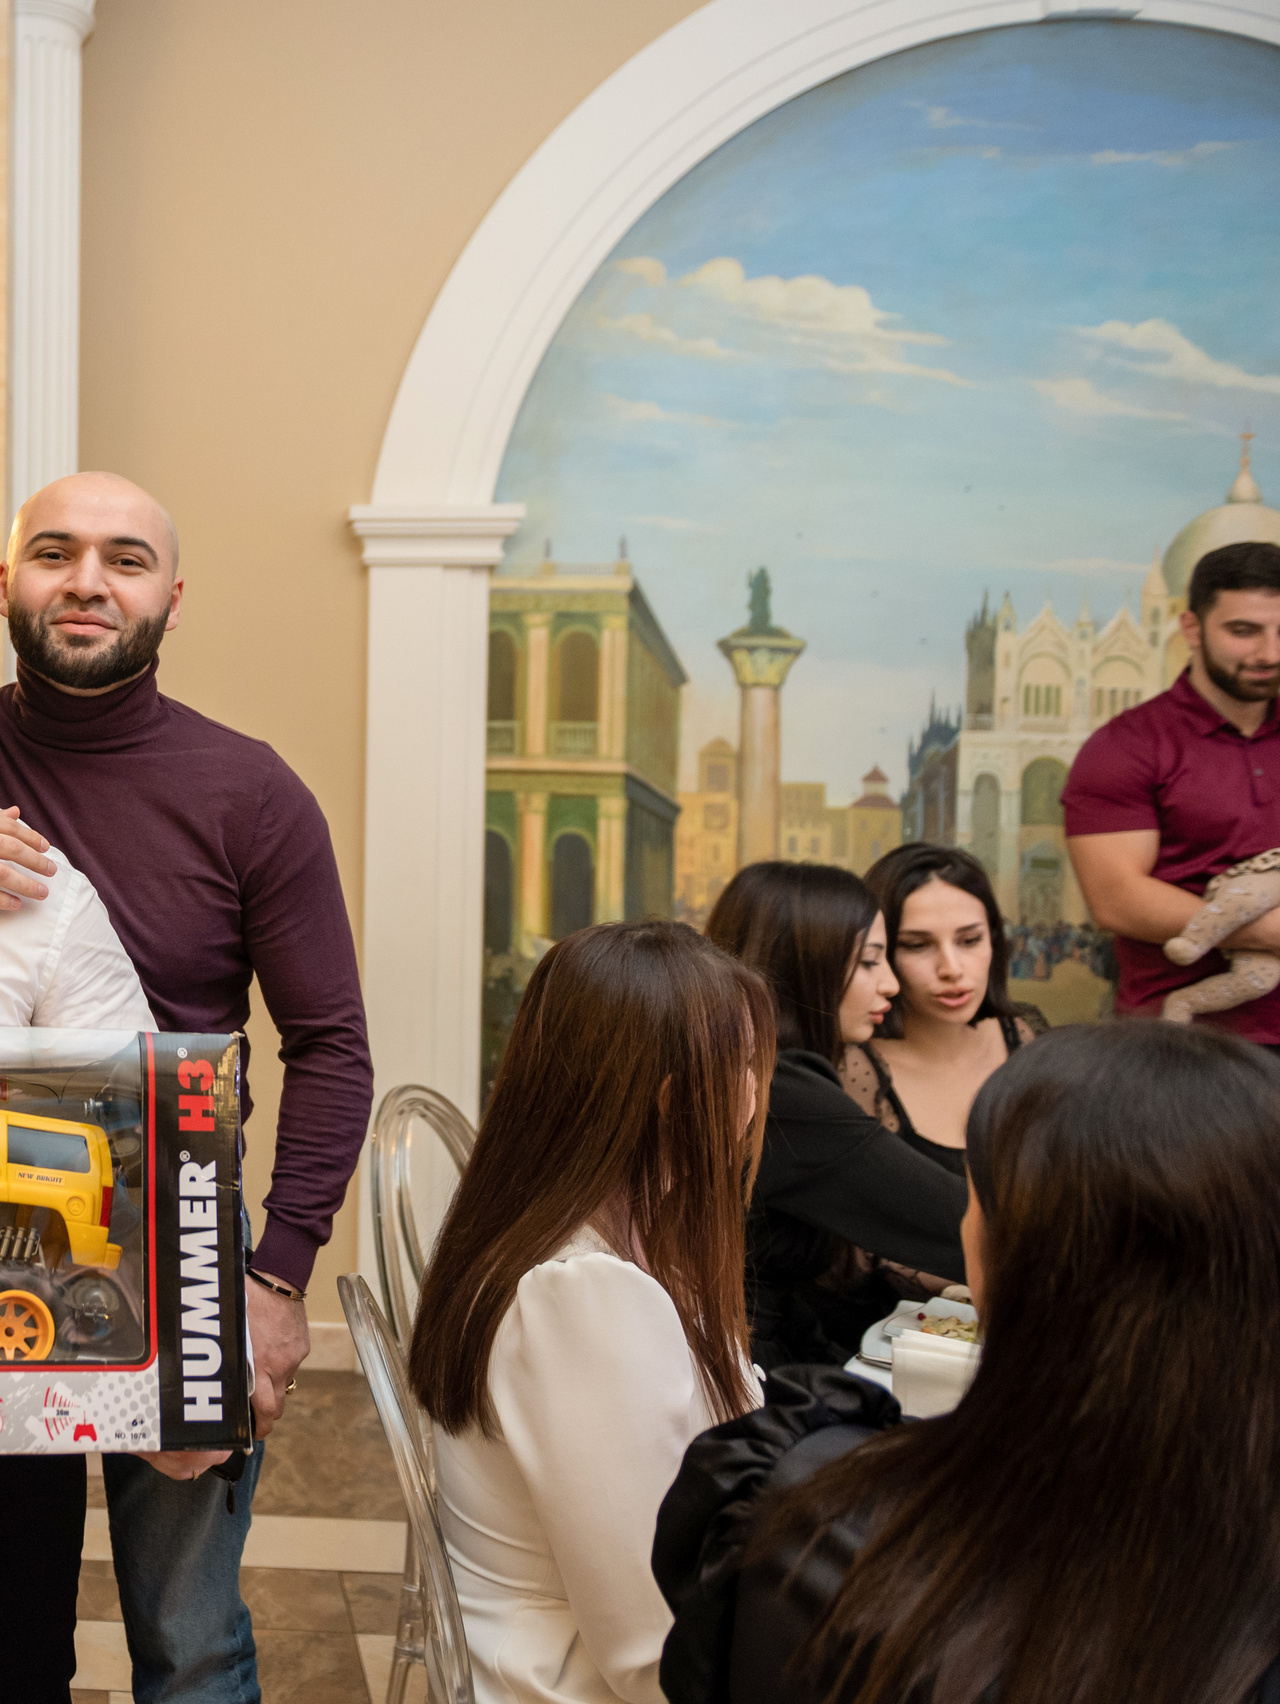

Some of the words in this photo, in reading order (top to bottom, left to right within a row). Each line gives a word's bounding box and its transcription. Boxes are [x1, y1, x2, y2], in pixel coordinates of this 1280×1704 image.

[178, 1059, 215, 1132] H3
[36, 1175, 63, 1183] BRIGHT
[178, 1160, 223, 1421] HUMMER
[131, 1418, 145, 1427] 6+
